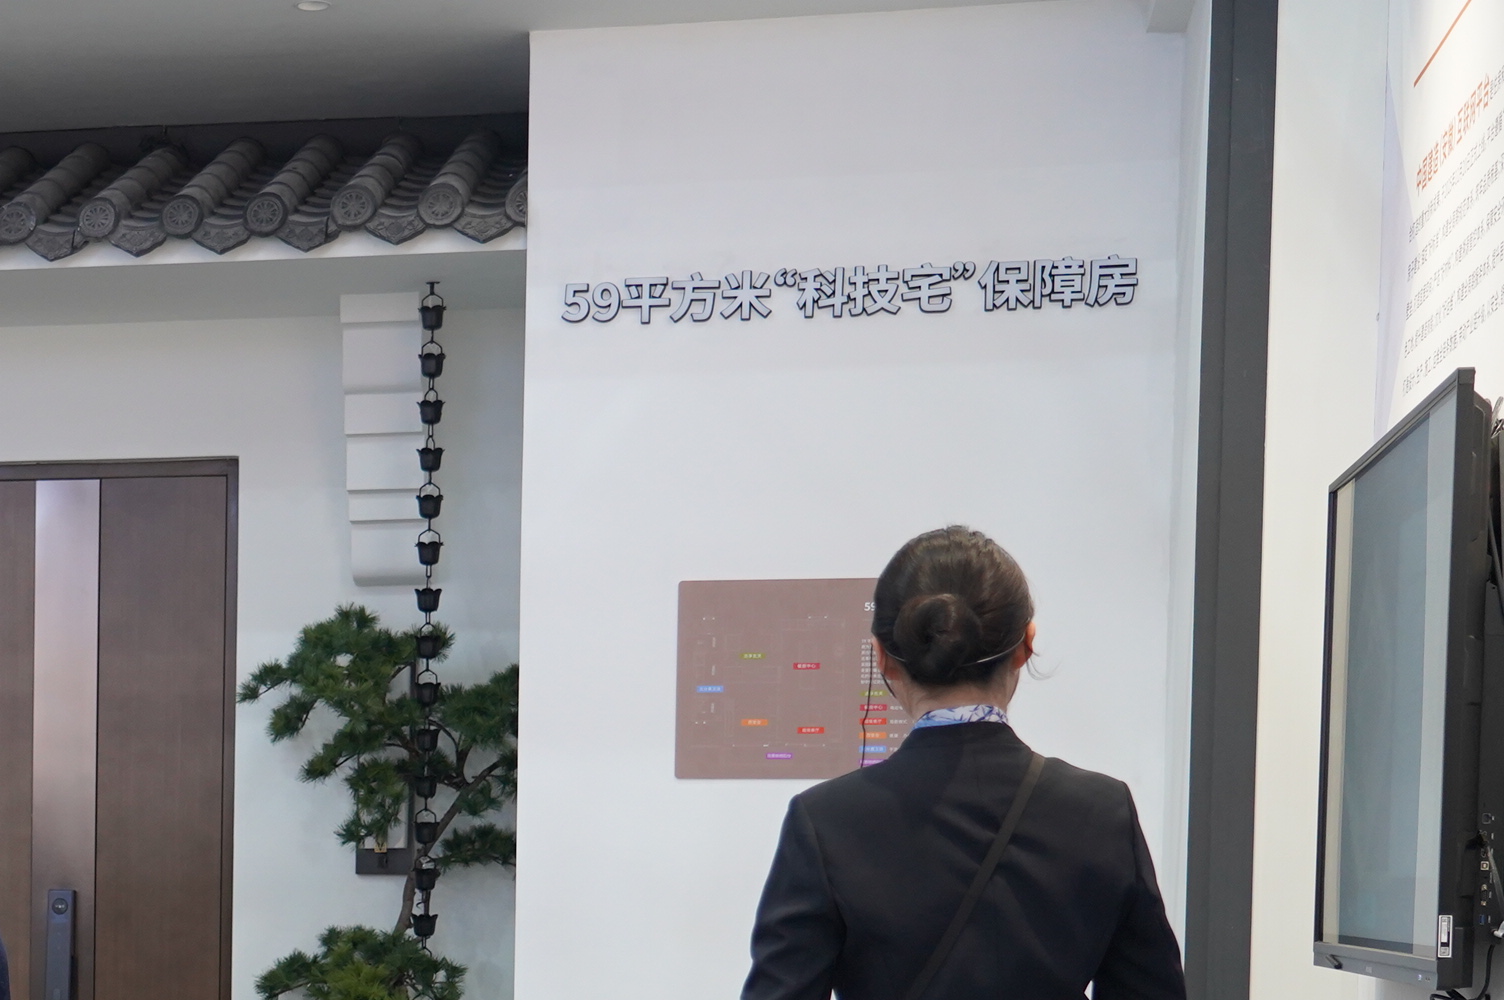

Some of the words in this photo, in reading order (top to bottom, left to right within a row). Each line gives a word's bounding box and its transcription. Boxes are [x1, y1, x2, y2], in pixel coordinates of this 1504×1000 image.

[561, 254, 1138, 325] 59平方米“科技宅”保障房
